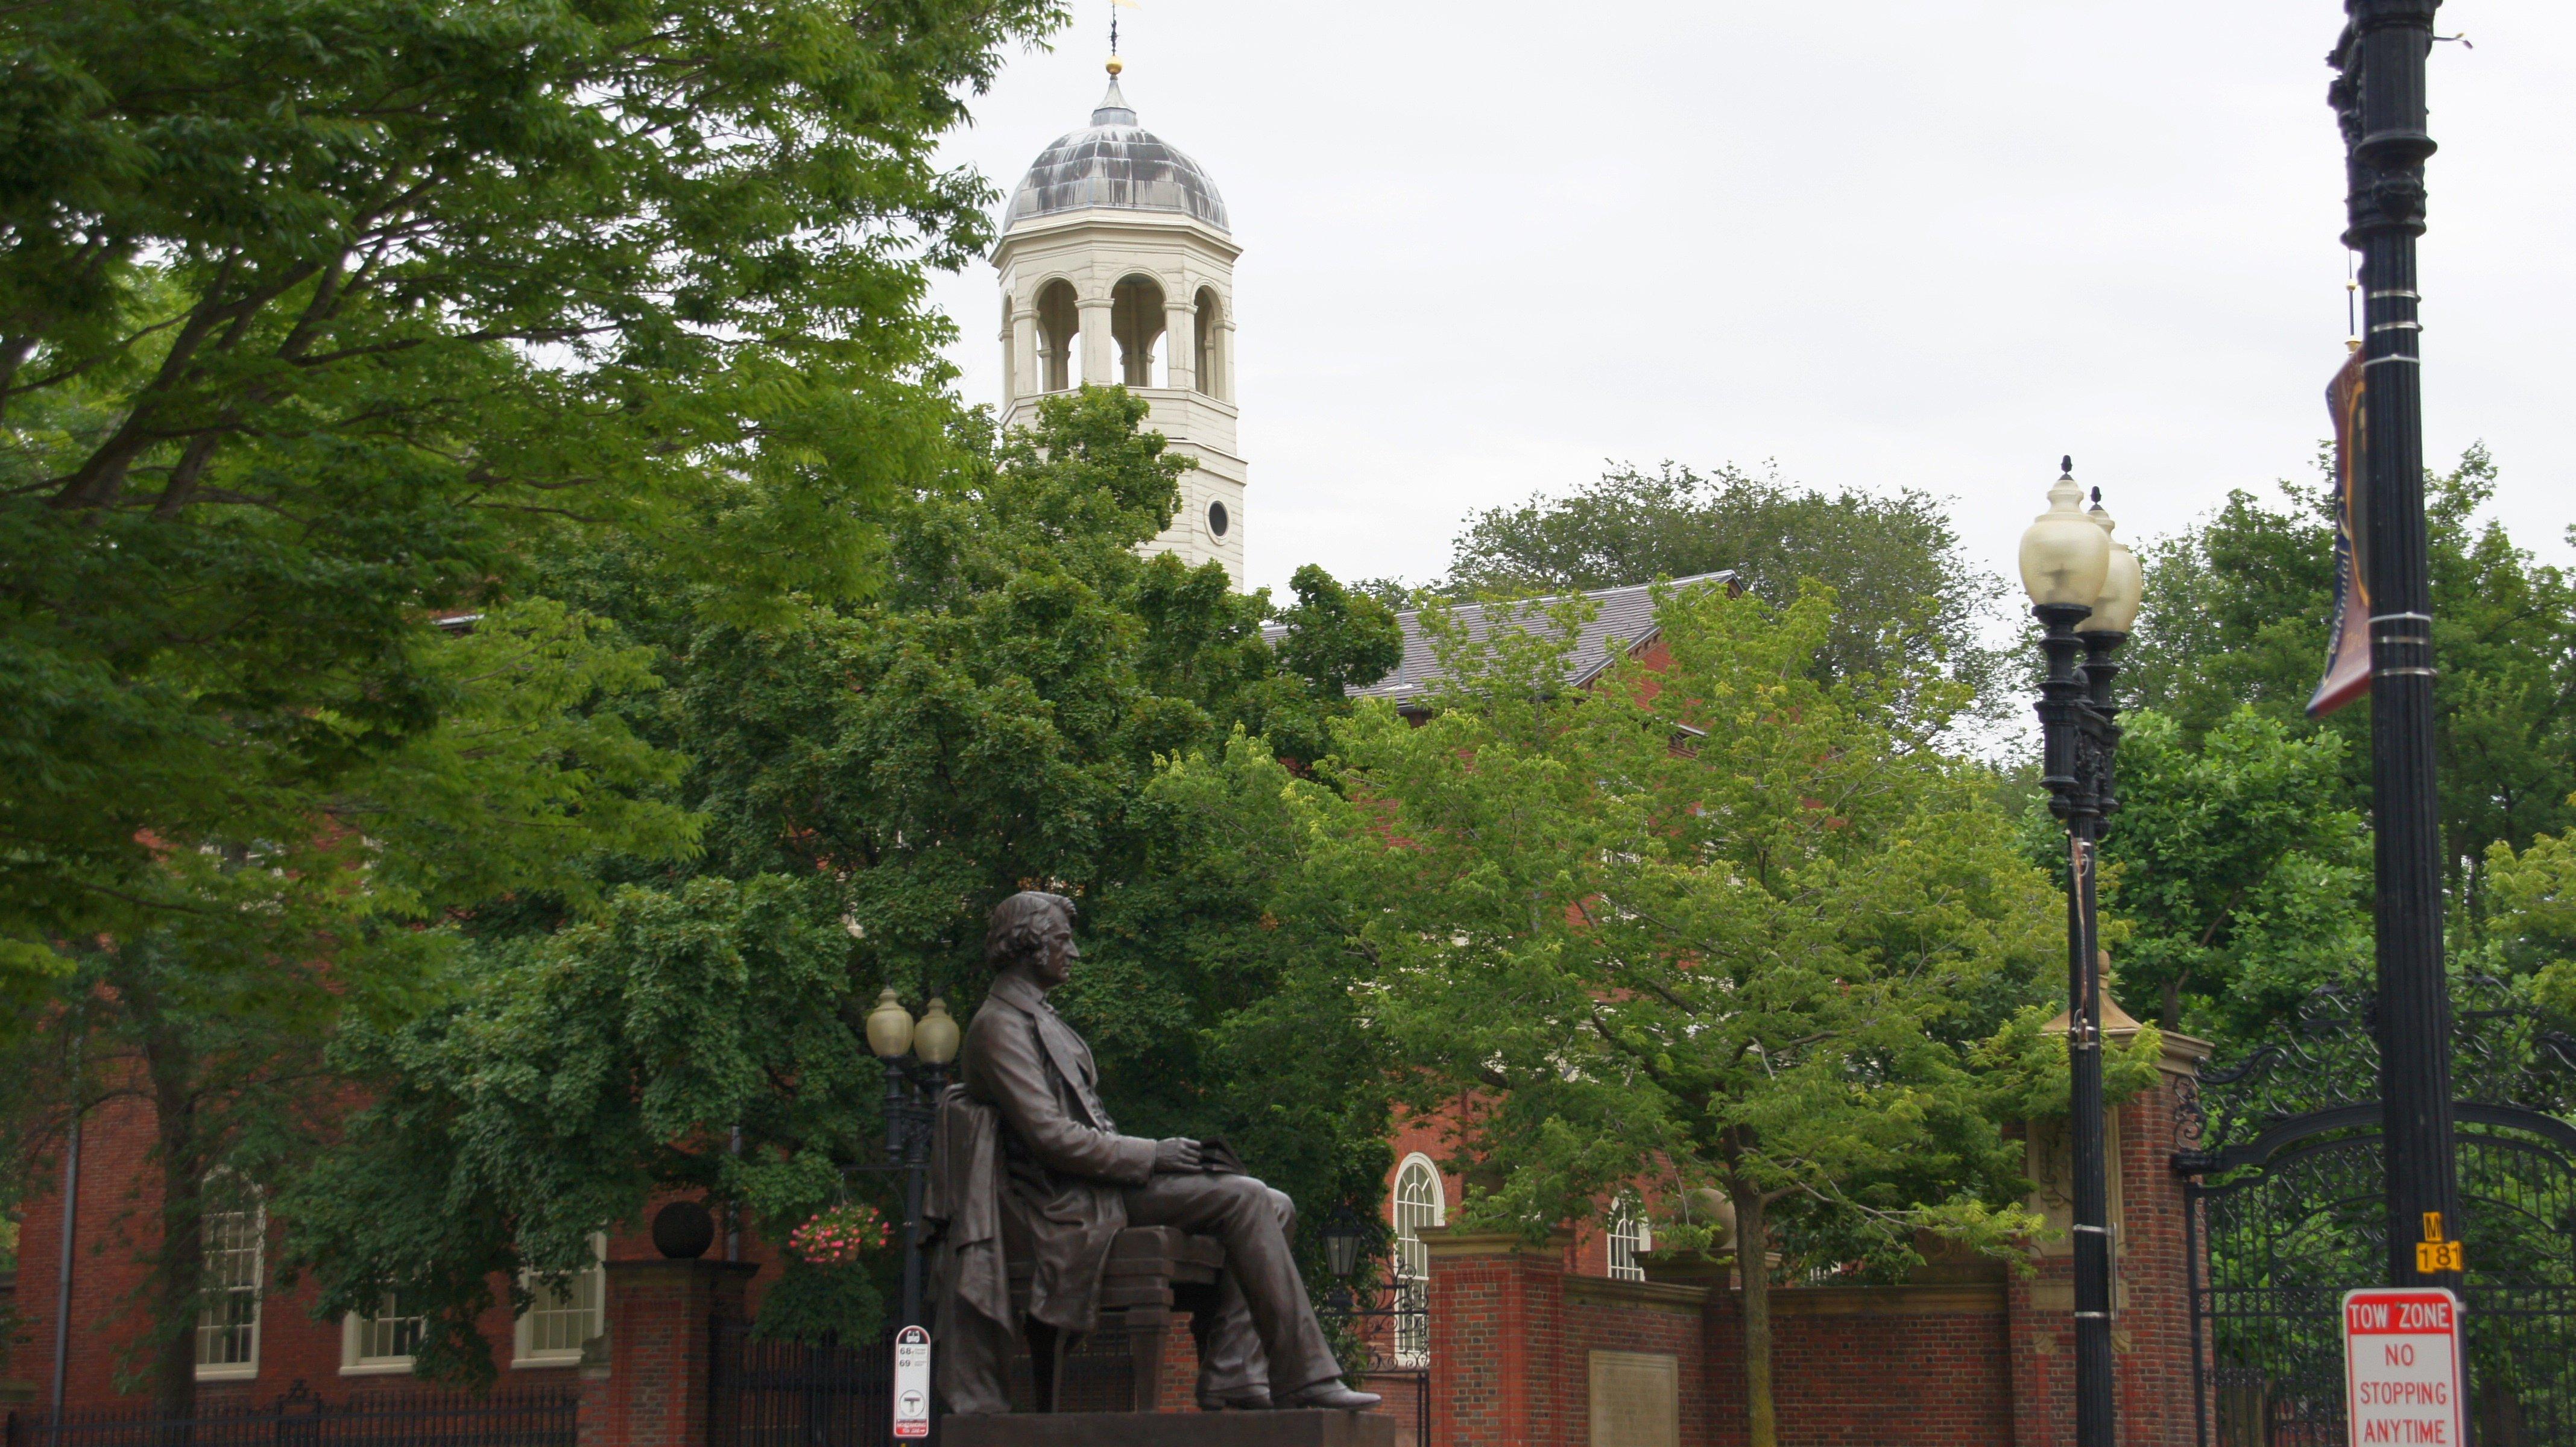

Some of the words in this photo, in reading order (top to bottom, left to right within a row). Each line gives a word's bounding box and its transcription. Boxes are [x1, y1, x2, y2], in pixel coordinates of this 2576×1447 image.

[2426, 1215, 2441, 1239] M
[2419, 1246, 2460, 1269] 181
[2349, 1304, 2387, 1328] TOW
[2399, 1302, 2450, 1328] ZONE
[2385, 1343, 2414, 1366] NO
[904, 1397, 920, 1412] T
[2360, 1381, 2446, 1405] STOPPING
[2364, 1419, 2446, 1444] ANYTIME
